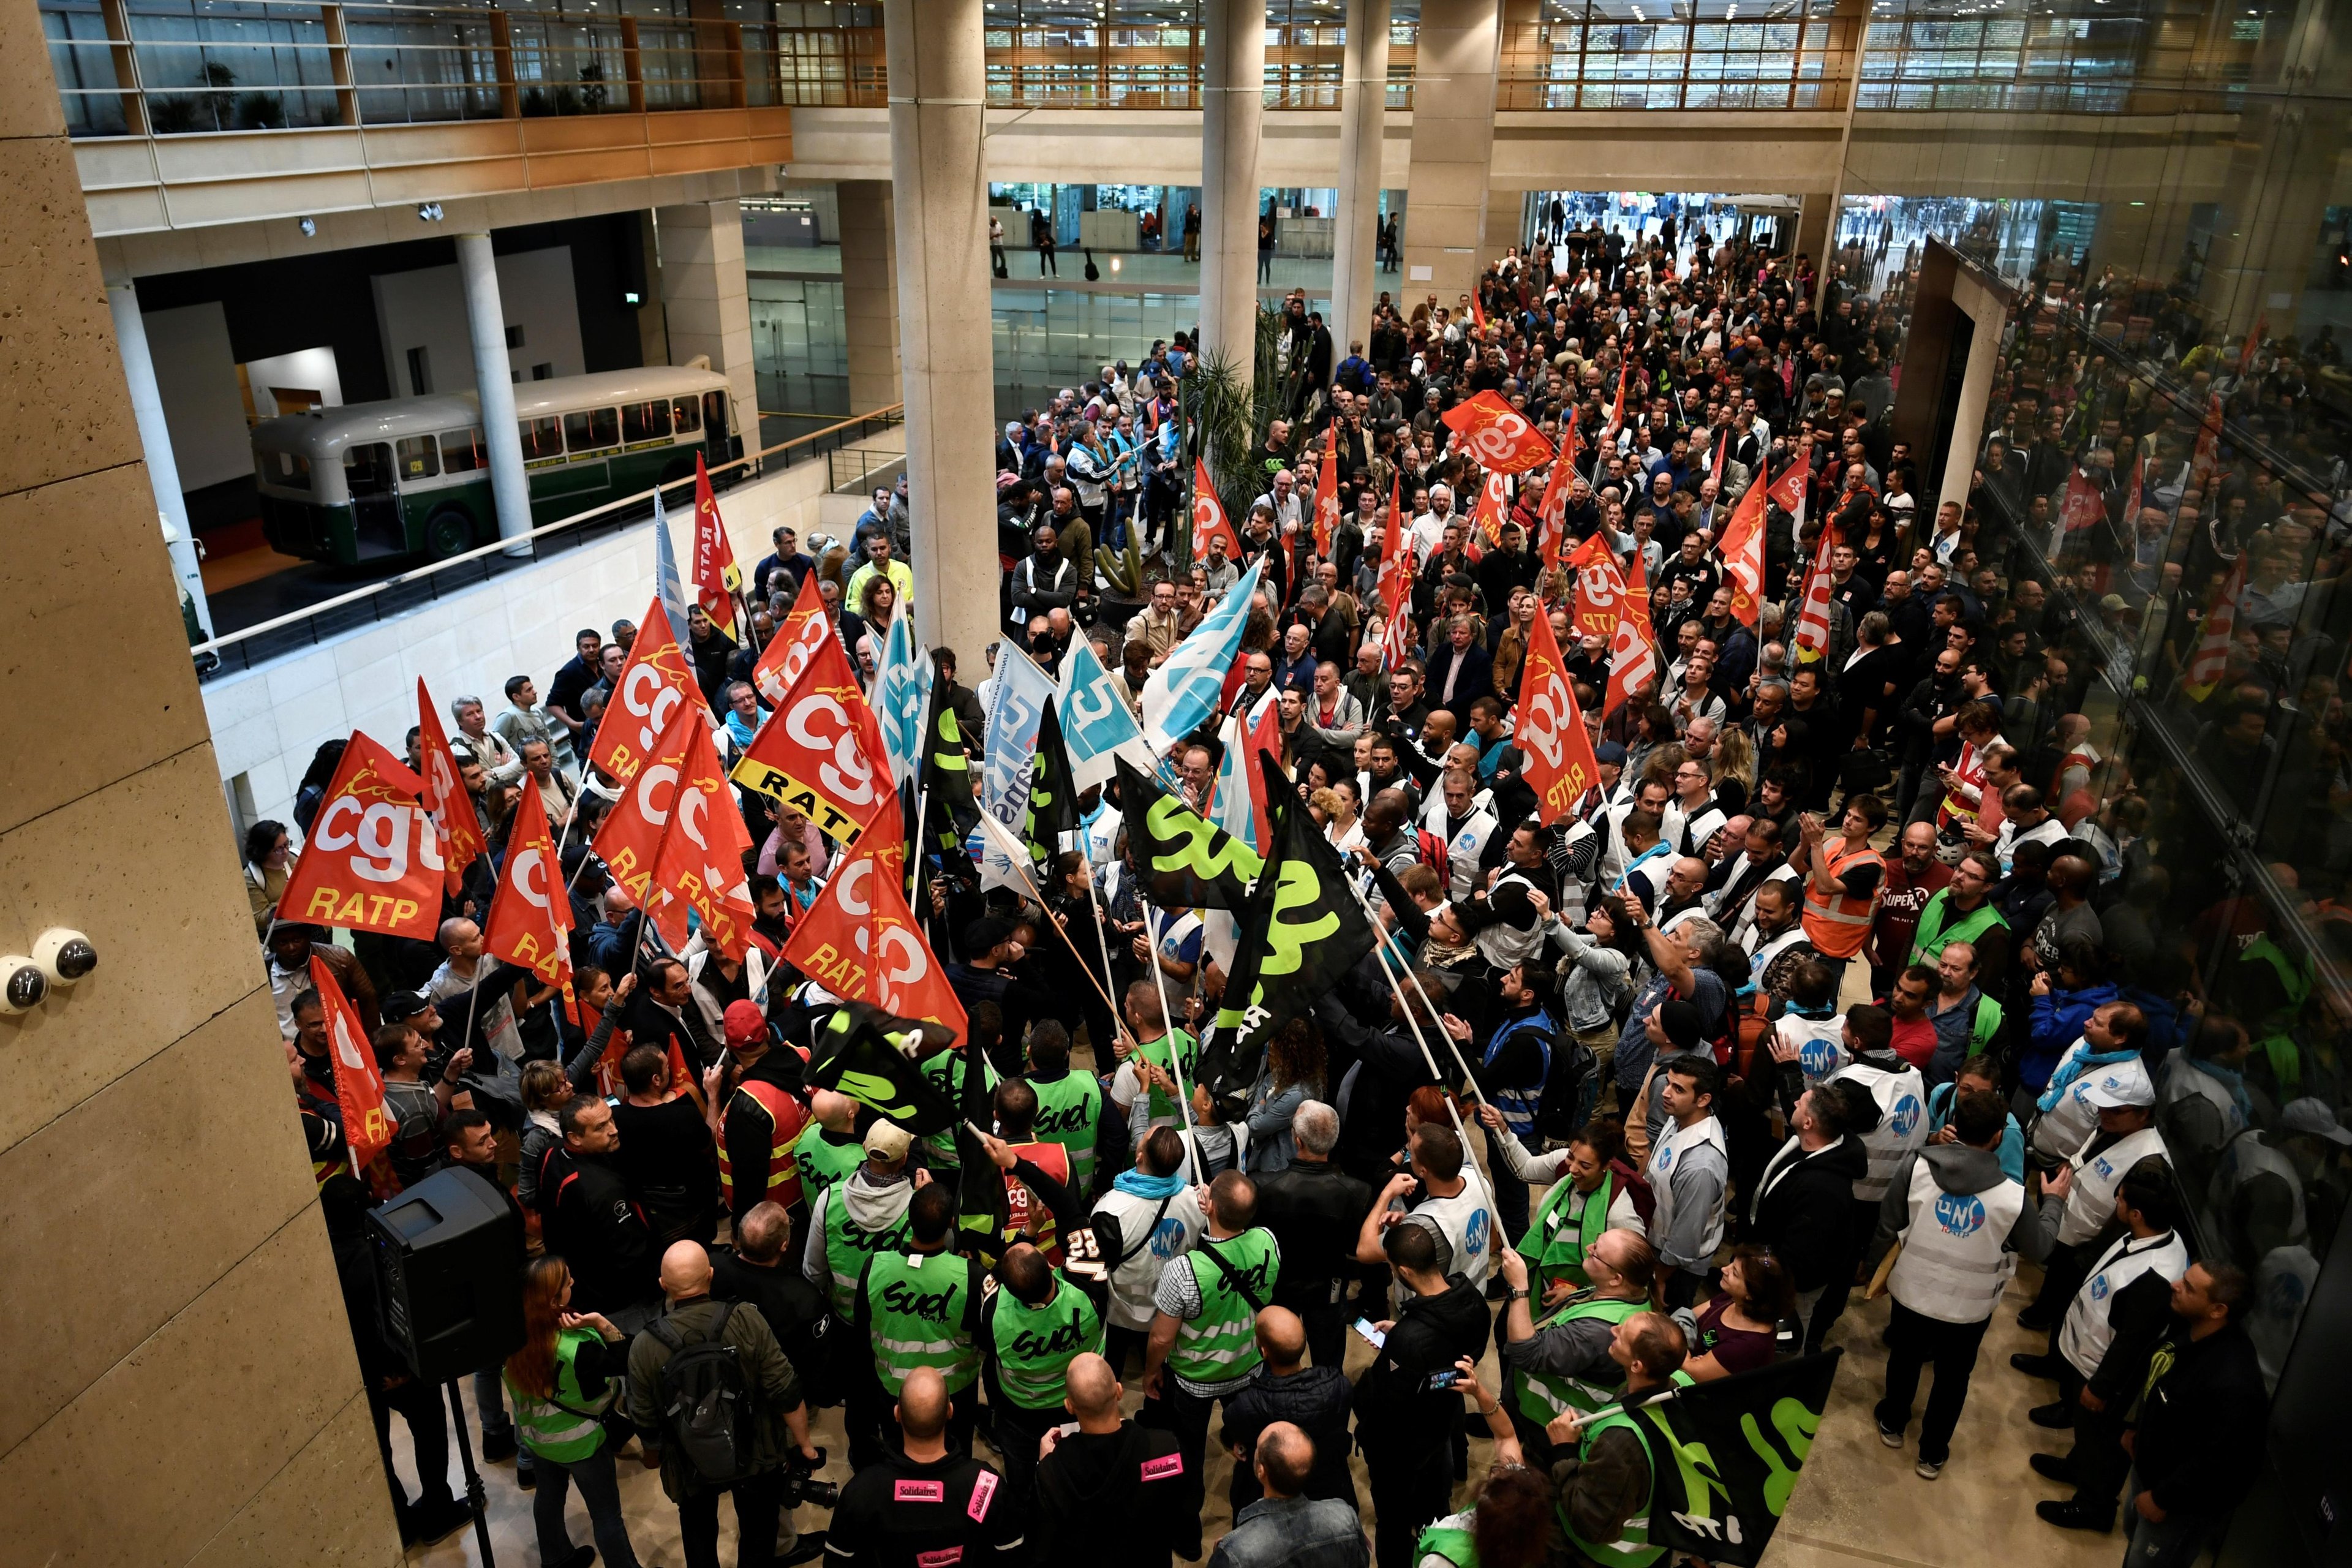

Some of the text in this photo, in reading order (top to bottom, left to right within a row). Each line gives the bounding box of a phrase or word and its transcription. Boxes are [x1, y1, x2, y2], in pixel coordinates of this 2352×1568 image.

[786, 693, 882, 807] cg
[314, 795, 444, 883] cgt
[306, 887, 420, 929] RATP
[1033, 1092, 1090, 1136] Sud
[1007, 1188, 1027, 1207] cg
[1940, 1224, 1972, 1239] RATP
[883, 1281, 957, 1317] Sud
[1012, 1307, 1084, 1361] Sud
[1145, 1461, 1178, 1476] Solidaires
[899, 1485, 937, 1496] Solidaires
